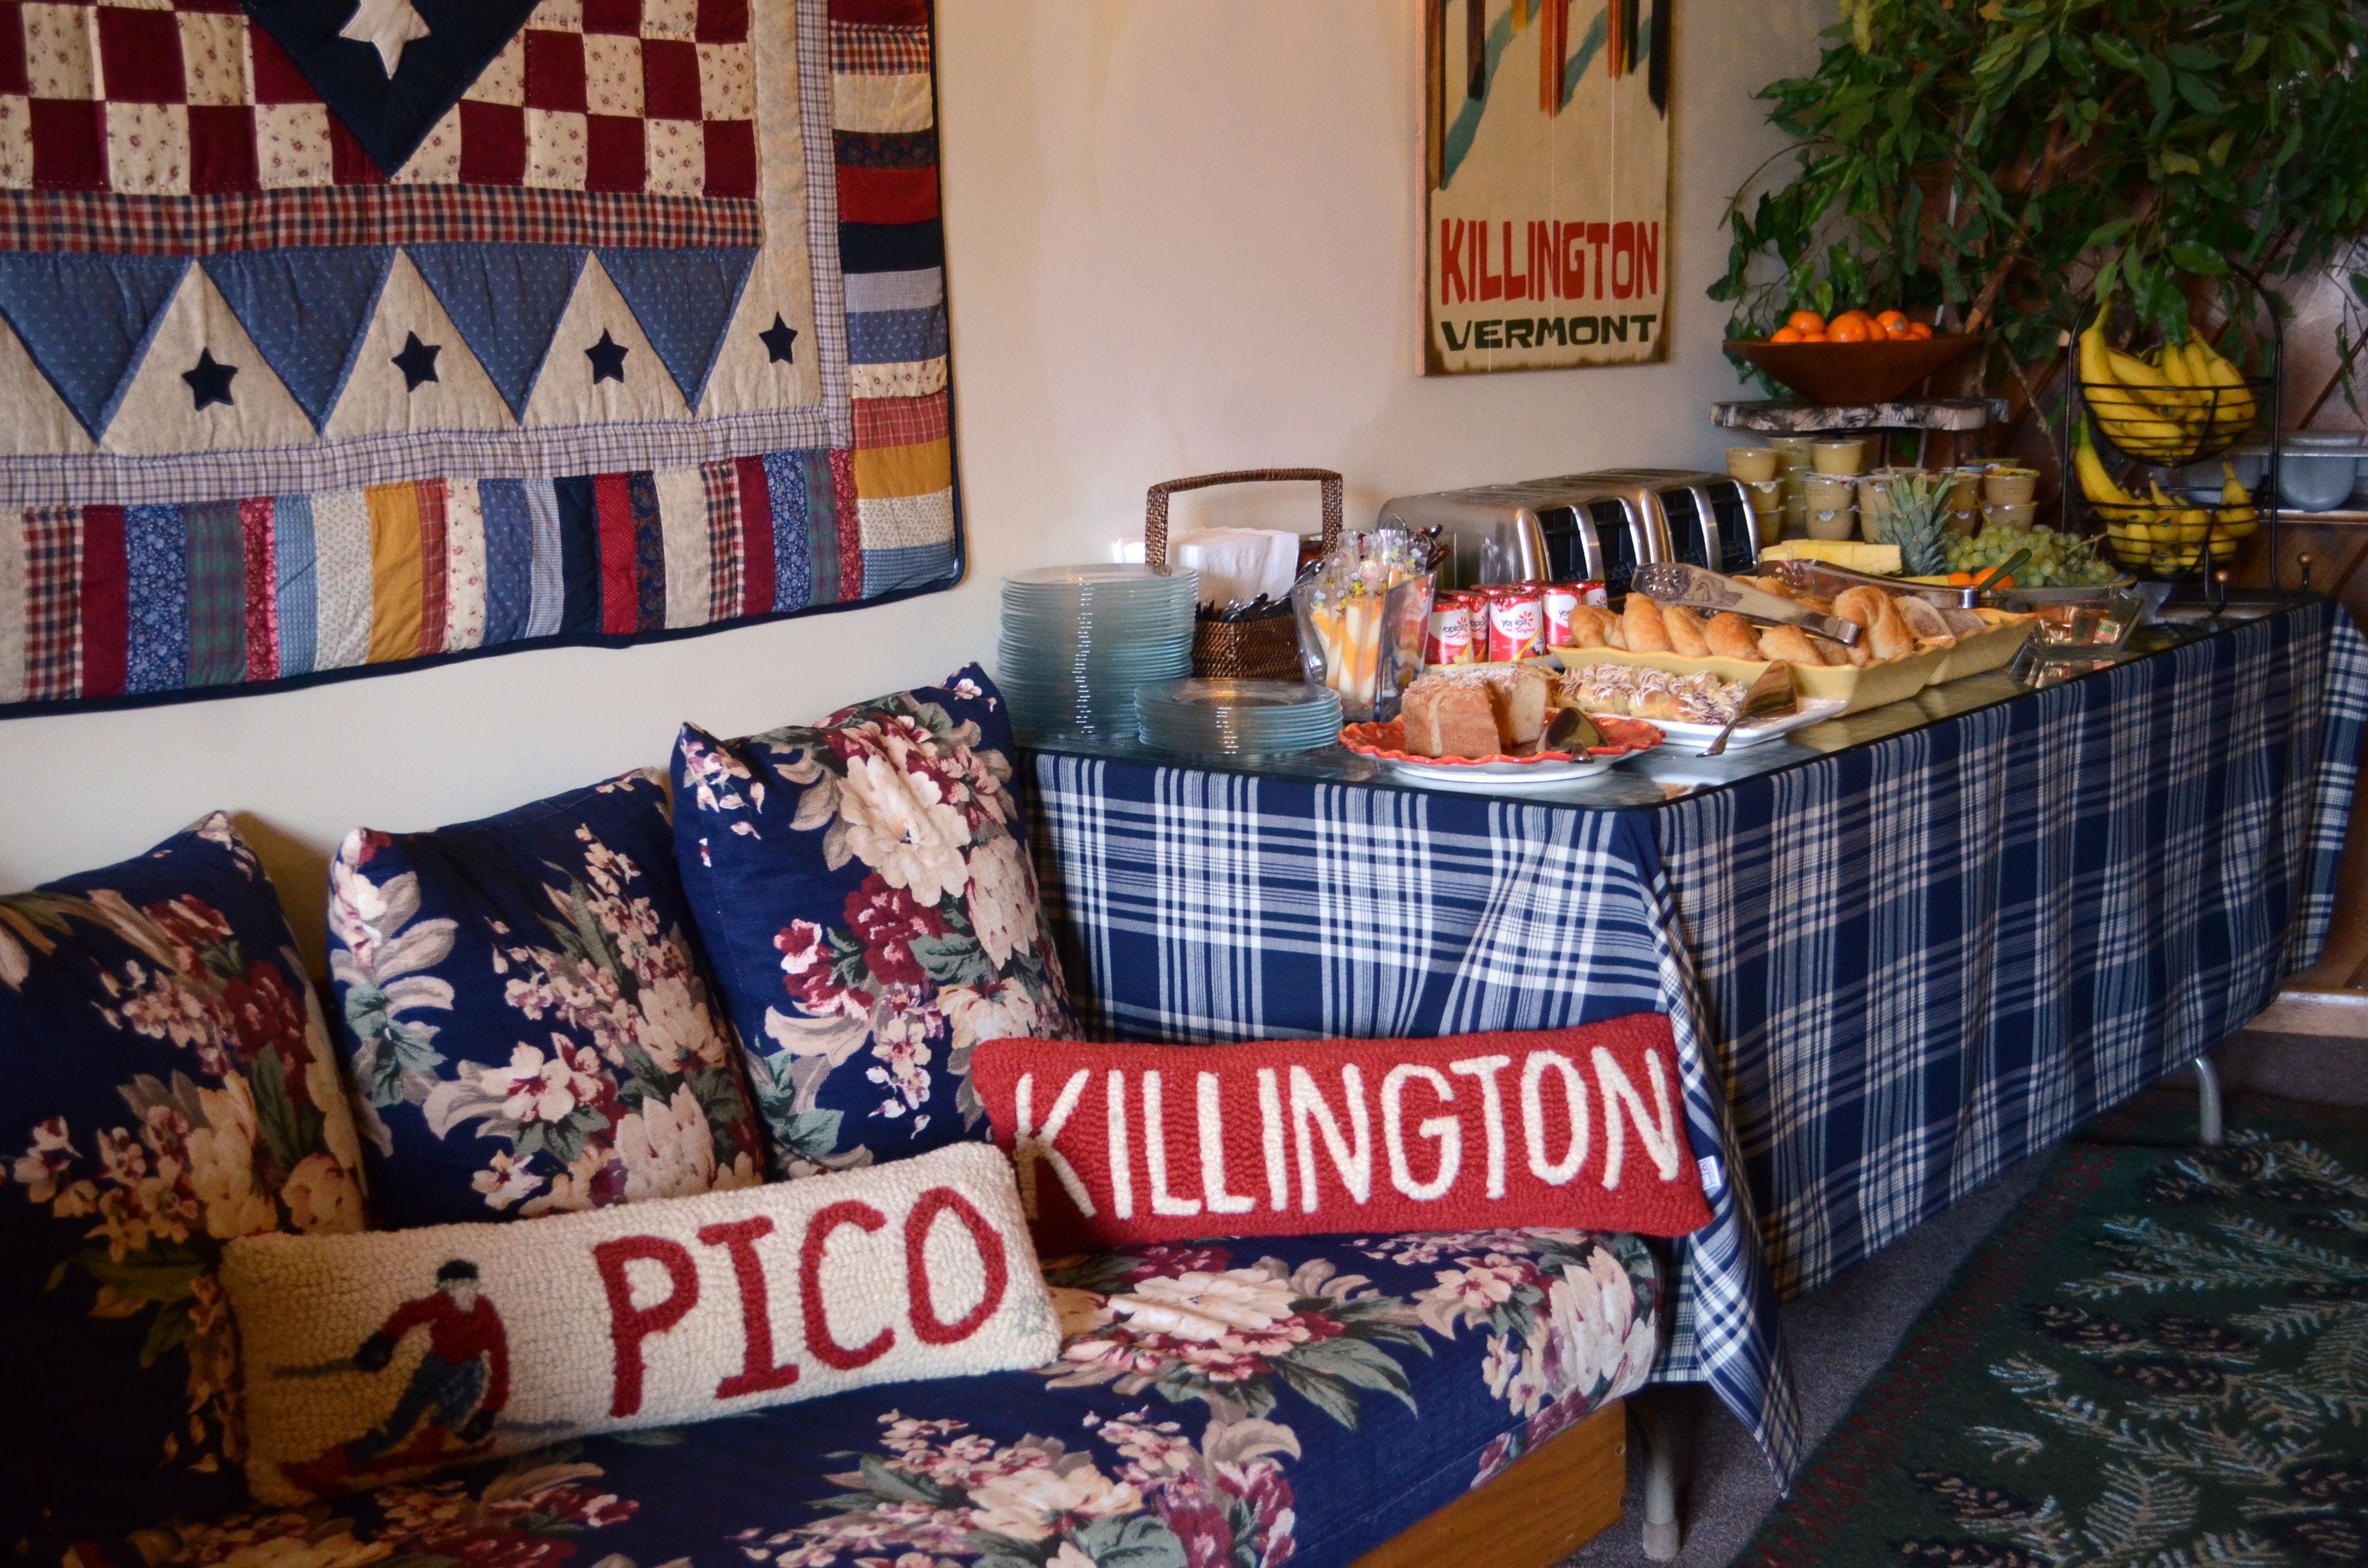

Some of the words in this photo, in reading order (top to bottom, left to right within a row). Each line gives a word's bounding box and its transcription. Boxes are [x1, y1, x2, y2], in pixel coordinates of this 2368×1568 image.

[1441, 218, 1659, 306] KILLINGTON
[1441, 314, 1657, 351] VERMONT
[1014, 1046, 1680, 1220] KILLINGTON
[593, 1186, 1008, 1418] PICO
